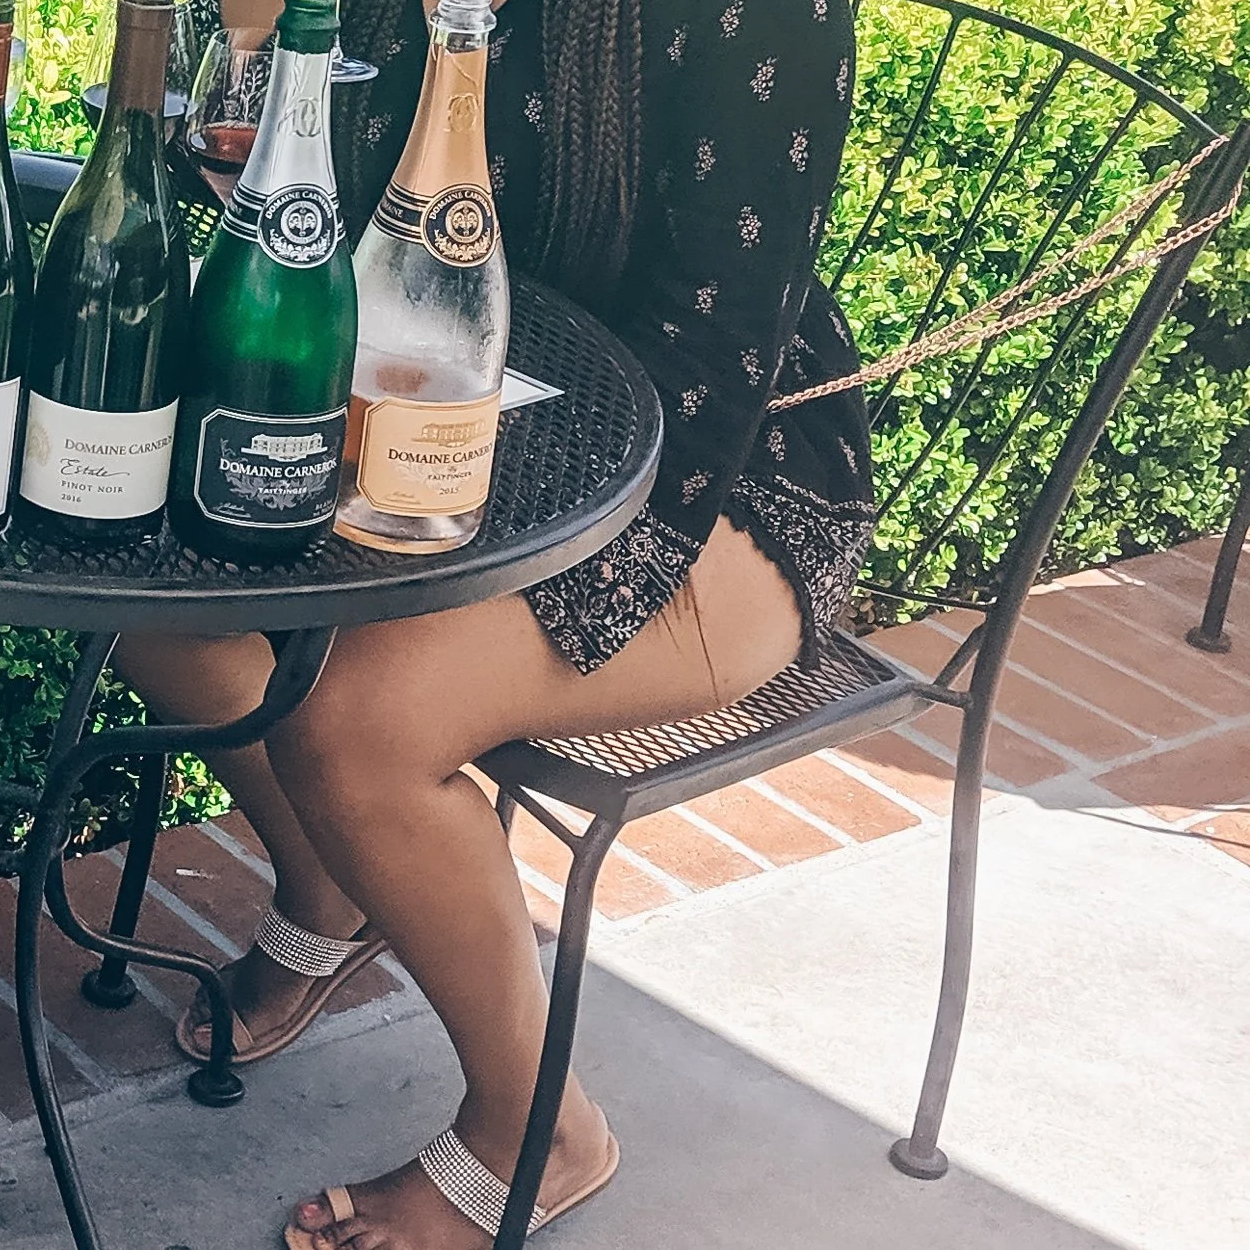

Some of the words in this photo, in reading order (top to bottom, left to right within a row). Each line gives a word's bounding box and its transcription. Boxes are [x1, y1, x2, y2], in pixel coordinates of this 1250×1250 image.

[265, 191, 301, 220] DOMAINE
[429, 191, 463, 220] DOMAINE
[65, 438, 127, 456] DOMAINE
[388, 448, 451, 464] DOMAINE
[59, 458, 131, 478] Estate
[219, 457, 283, 478] DOMAINE
[284, 456, 338, 478] CARNEROS
[60, 480, 94, 493] PINOT
[97, 486, 125, 494] NOIR
[60, 493, 83, 503] 2016
